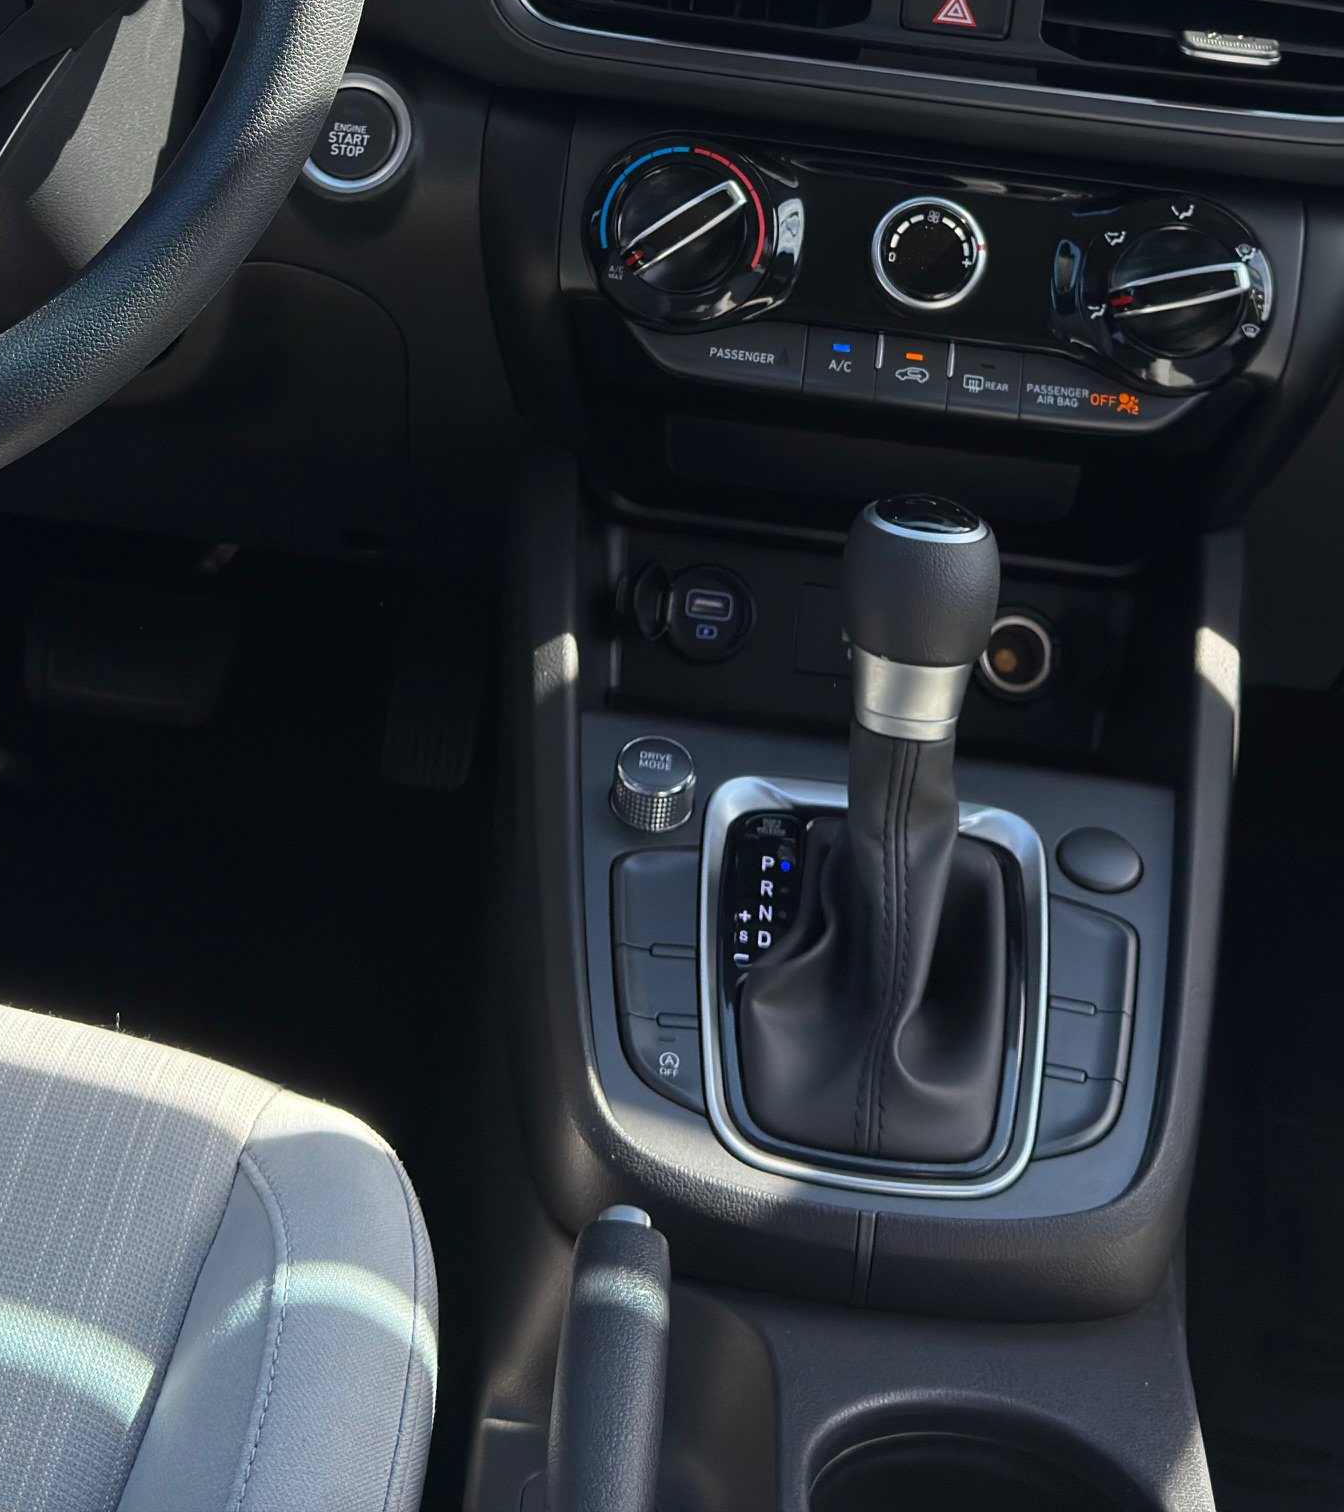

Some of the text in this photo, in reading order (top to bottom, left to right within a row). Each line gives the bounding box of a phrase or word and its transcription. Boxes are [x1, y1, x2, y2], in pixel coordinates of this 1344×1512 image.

[334, 122, 368, 134] ENGINE
[328, 131, 370, 146] START
[330, 143, 365, 157] STOP
[709, 347, 775, 365] PASSENGER
[828, 359, 852, 373] A/C
[984, 380, 1009, 393] REAR
[1026, 383, 1089, 399] PASSENGER
[1036, 394, 1079, 408] AIR BAG
[1090, 393, 1118, 408] OFF
[639, 750, 673, 762] DRIVE
[639, 758, 672, 772] MODE
[761, 855, 775, 872] P
[760, 880, 774, 898] R
[758, 904, 773, 923] N
[757, 930, 772, 949] D
